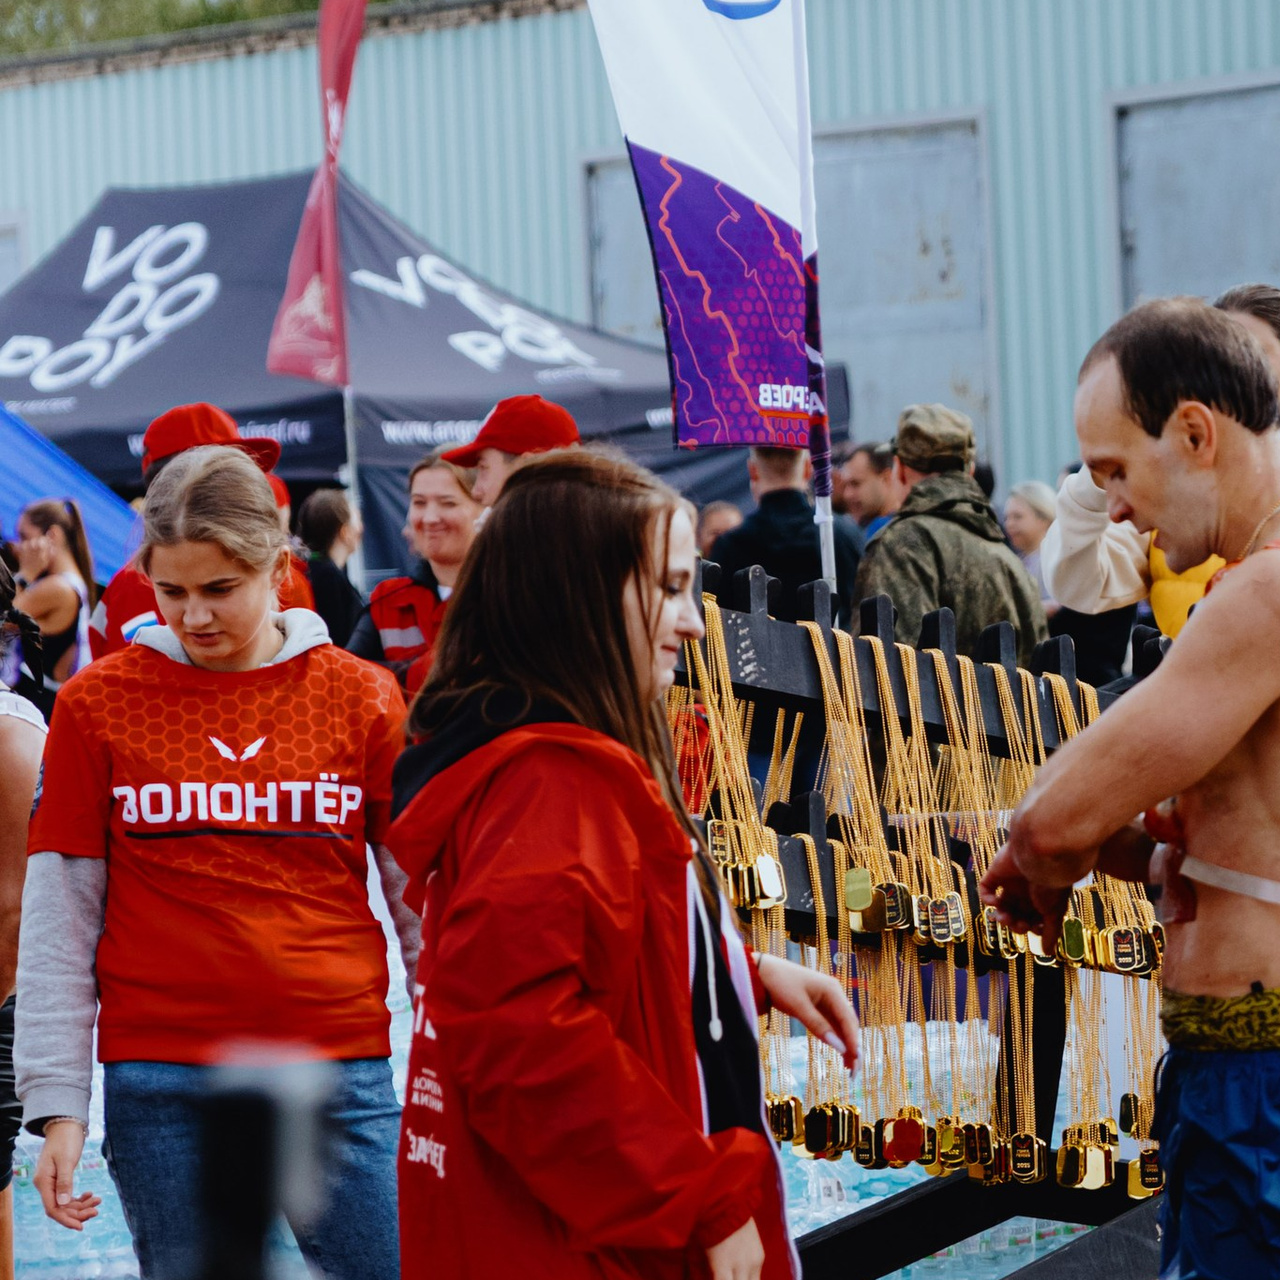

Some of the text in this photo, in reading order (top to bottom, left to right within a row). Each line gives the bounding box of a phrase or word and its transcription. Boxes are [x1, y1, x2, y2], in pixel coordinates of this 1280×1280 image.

[82, 222, 209, 294] VO
[82, 272, 220, 340] DO
[112, 772, 363, 825] ВОЛОНТЁР
